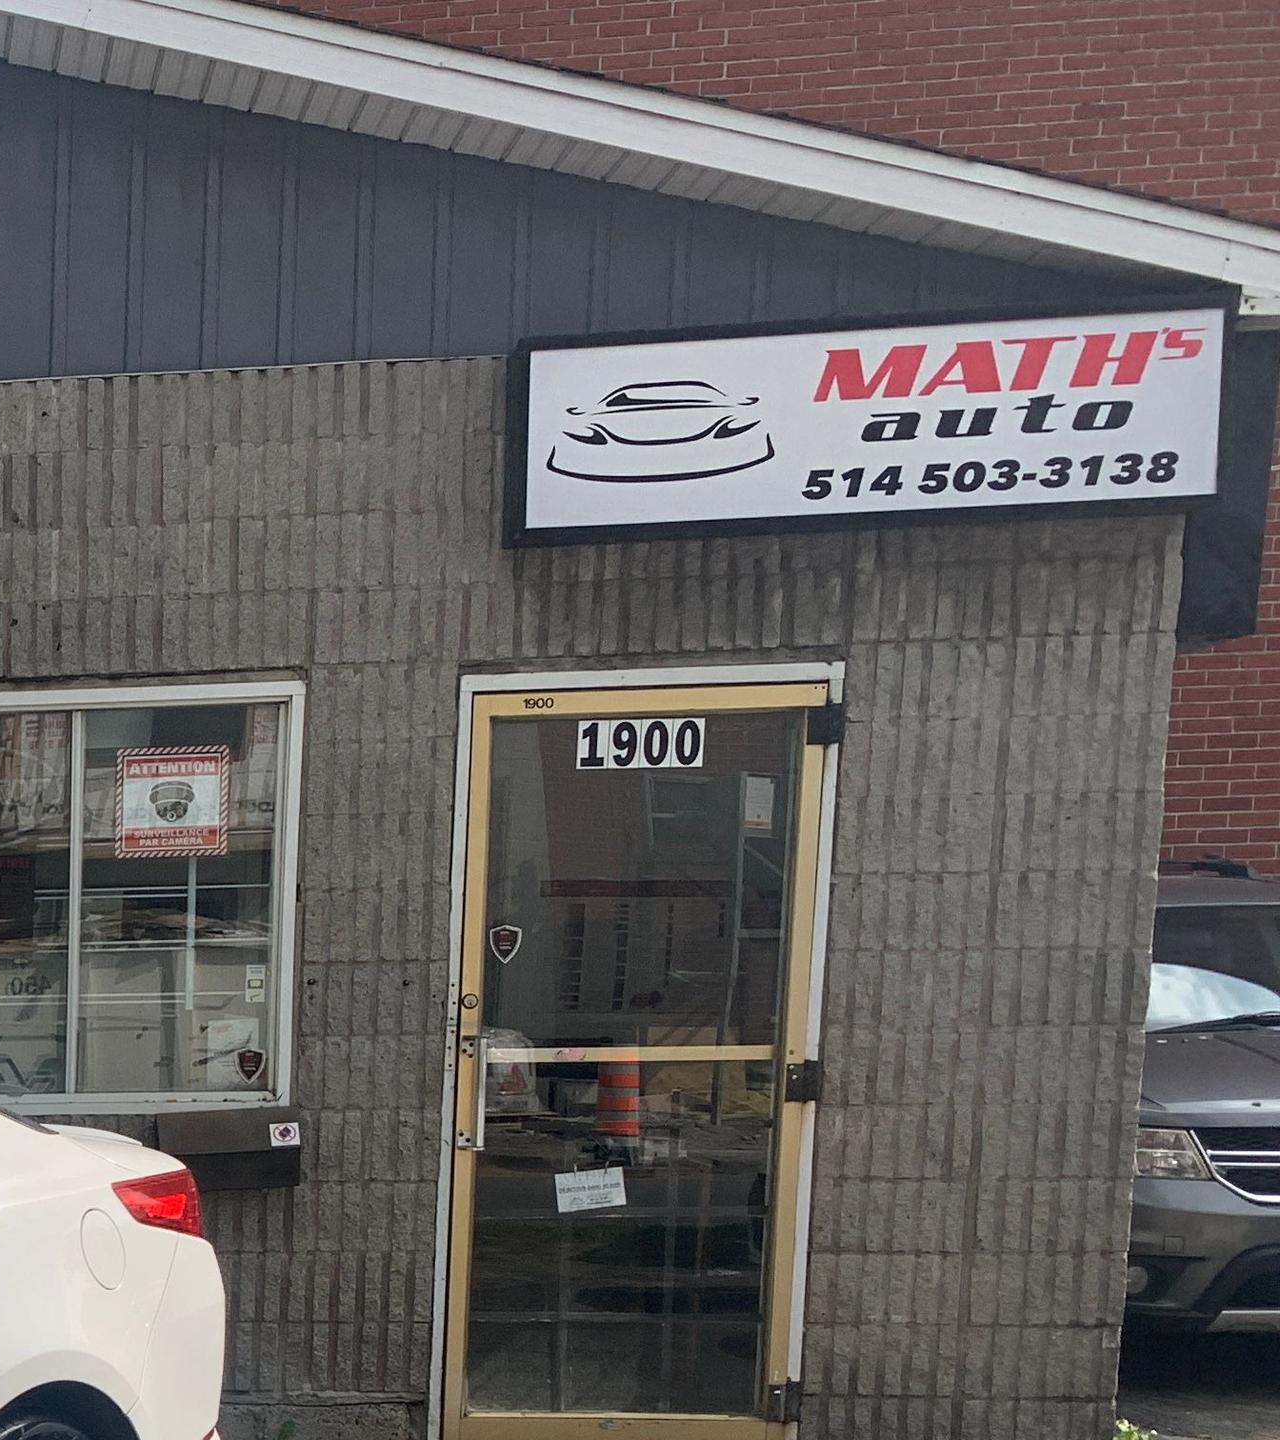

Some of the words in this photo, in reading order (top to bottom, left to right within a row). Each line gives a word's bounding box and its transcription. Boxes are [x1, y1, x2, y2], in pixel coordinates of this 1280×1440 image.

[861, 393, 1135, 443] auto
[802, 465, 905, 501] 514
[918, 452, 1181, 496] 503-3138
[523, 697, 554, 709] 1900
[579, 720, 701, 767] 1900
[128, 760, 217, 776] ATTENTION
[132, 828, 210, 838] SURVEILLANCE
[139, 838, 159, 846] PAR
